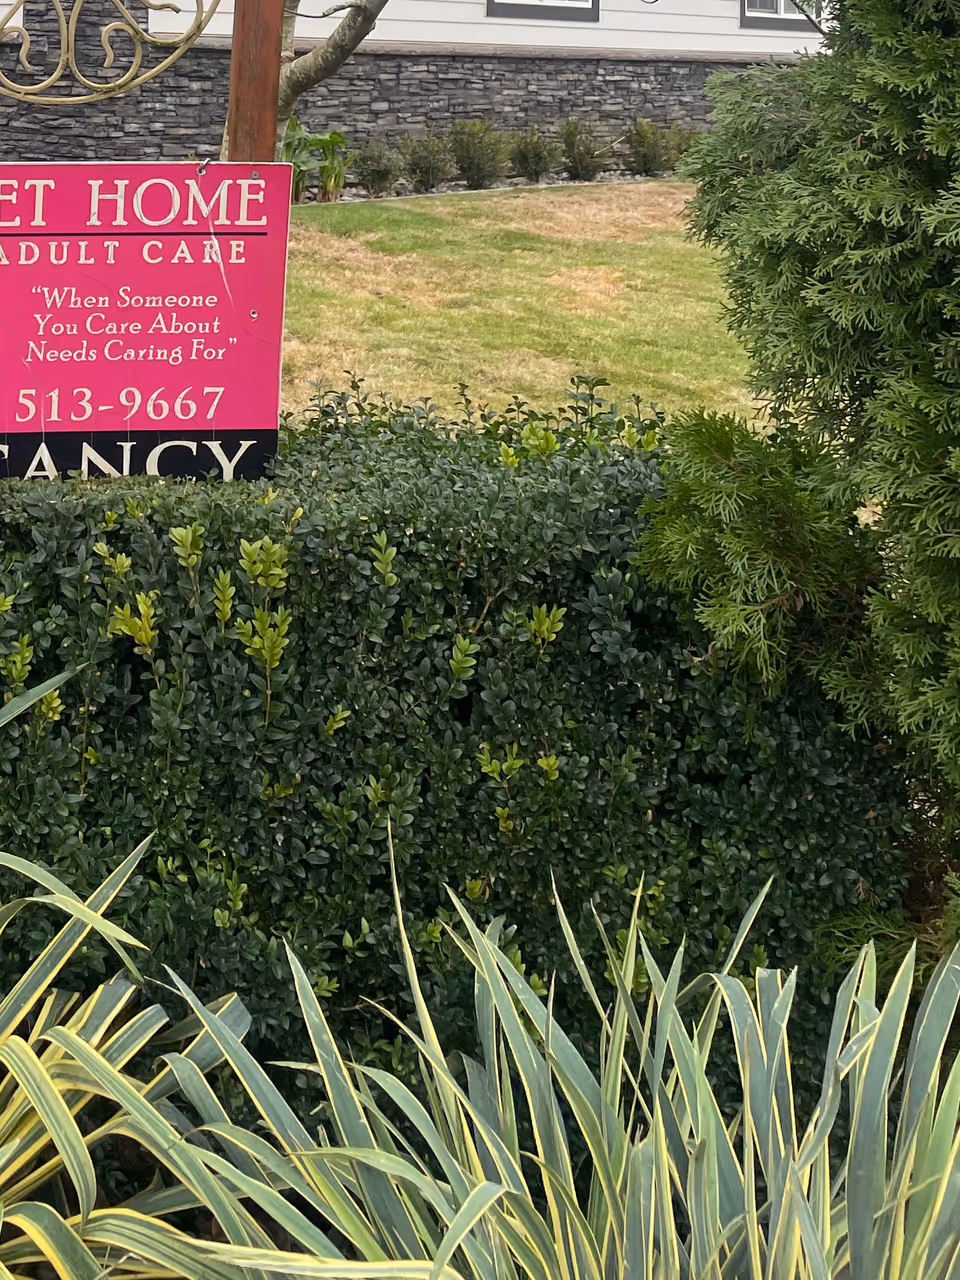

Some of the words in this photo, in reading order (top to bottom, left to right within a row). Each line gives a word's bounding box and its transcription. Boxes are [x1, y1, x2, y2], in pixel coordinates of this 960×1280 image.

[85, 178, 268, 227] HOME
[141, 240, 246, 264] CARE
[31, 285, 110, 309] “When
[117, 285, 218, 308] Someone
[33, 313, 79, 336] You
[85, 312, 142, 335] Care
[147, 312, 221, 334] About
[25, 339, 98, 362] Needs
[103, 339, 183, 365] Caring
[189, 337, 238, 360] For”
[15, 386, 226, 422] 513-9667
